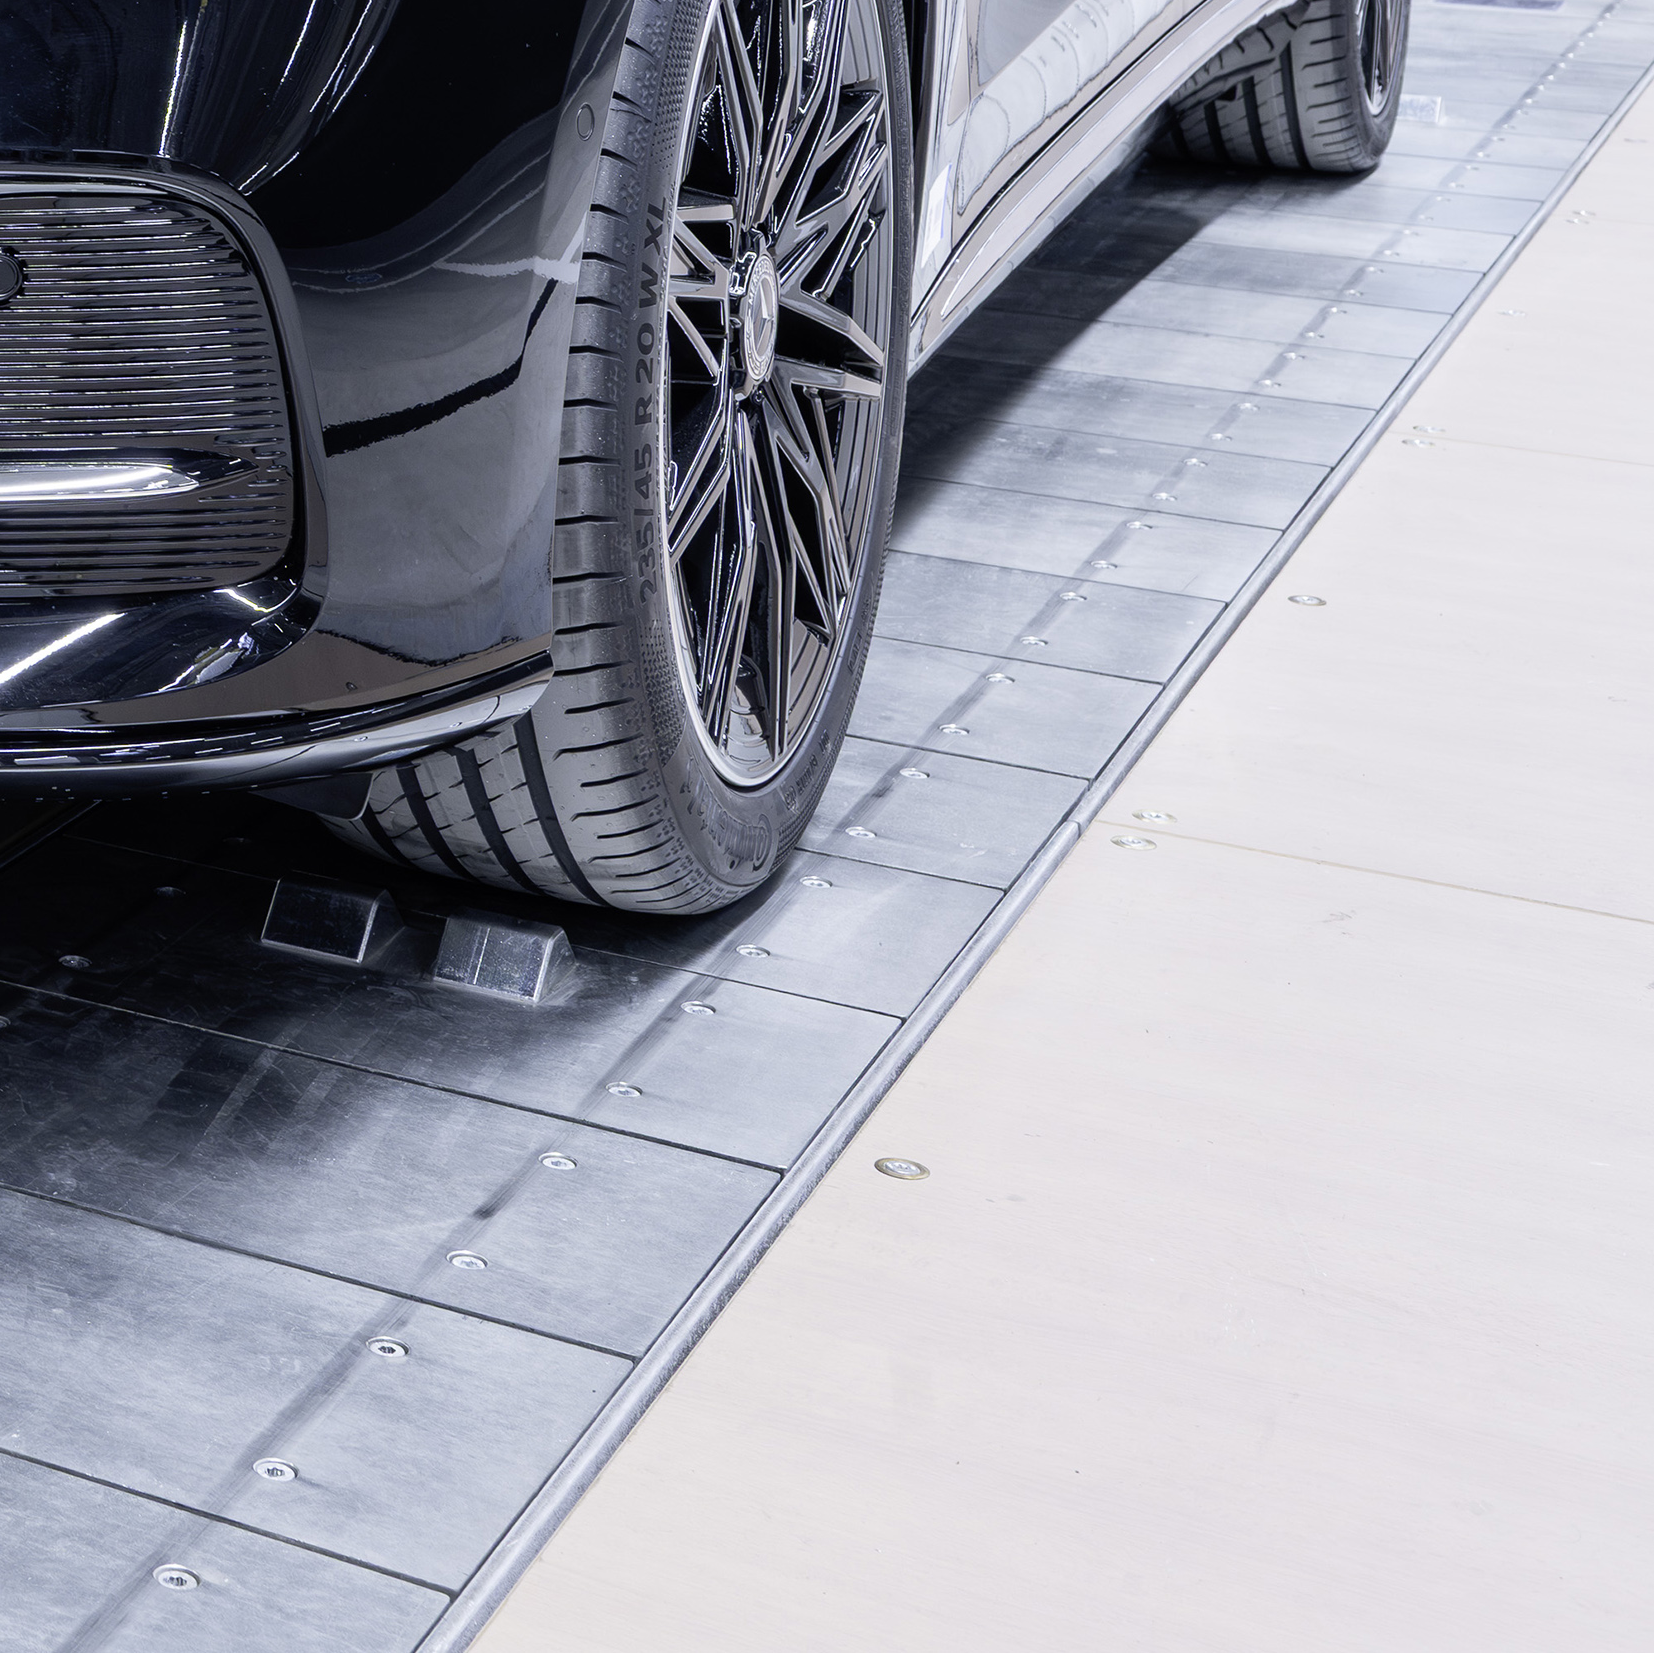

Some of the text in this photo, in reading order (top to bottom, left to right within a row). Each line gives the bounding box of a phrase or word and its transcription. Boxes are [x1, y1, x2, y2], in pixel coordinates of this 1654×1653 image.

[634, 196, 668, 606] 235/45 R 20 W XL
